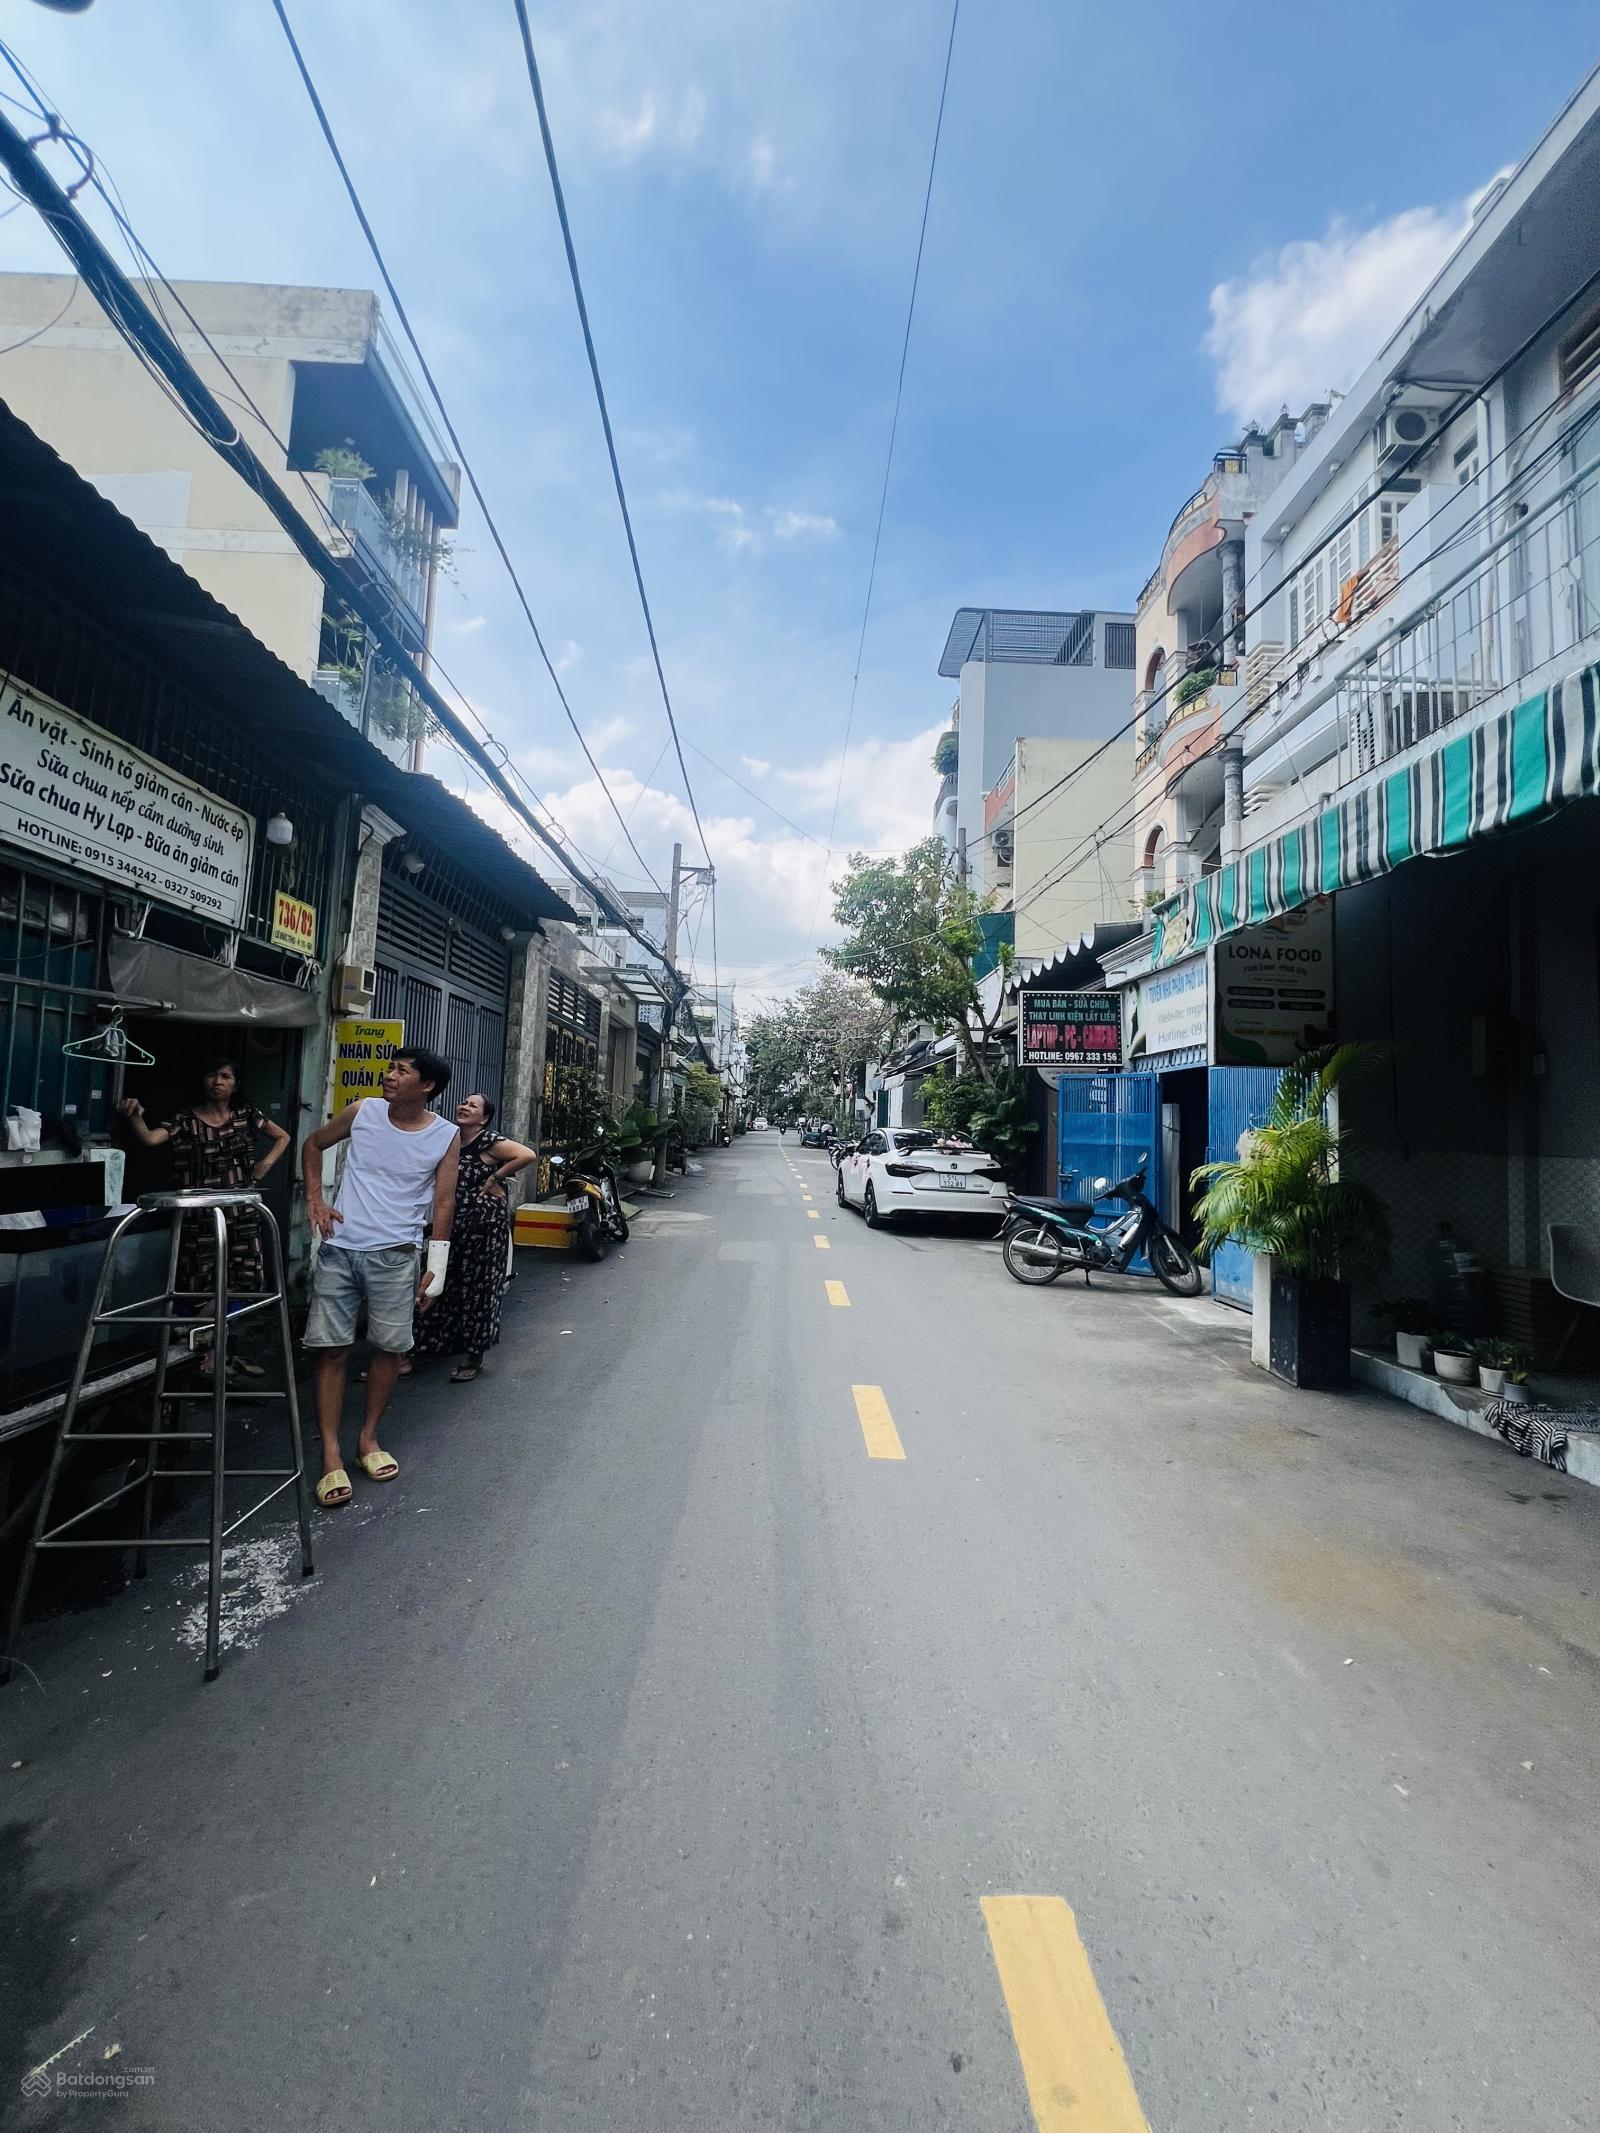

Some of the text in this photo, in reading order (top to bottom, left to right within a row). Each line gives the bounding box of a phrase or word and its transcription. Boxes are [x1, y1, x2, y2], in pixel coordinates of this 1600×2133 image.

[7, 694, 34, 728] Ăn
[39, 718, 68, 745] vặt
[79, 738, 114, 771] Sinh
[117, 760, 135, 779] tố
[134, 772, 168, 800] giảm
[171, 792, 193, 813] cân
[201, 805, 230, 833] Nước
[231, 822, 244, 842] ép
[37, 749, 224, 856] Sữa chua nếp cẩm dưỡng sinh
[0, 762, 35, 796] Sữa
[38, 784, 80, 816] chua
[83, 802, 106, 830] Hy
[107, 813, 134, 842] Lạp
[144, 831, 171, 857] Bữa
[172, 844, 189, 865] ăn
[189, 855, 219, 879] giảm
[220, 869, 239, 888] cân
[17, 817, 82, 854] HOTLINE:
[84, 846, 115, 867] 0915
[116, 859, 157, 884] 344242
[164, 879, 188, 896] 0327
[190, 889, 222, 910] 509292
[279, 899, 312, 936] 736/82
[1228, 945, 1322, 962] LONA FOOD
[1034, 999, 1050, 1008] MUA
[1052, 998, 1067, 1008] BÁN
[1028, 1011, 1047, 1021] THAY
[1049, 1011, 1066, 1021] LINH
[1067, 1010, 1083, 1022] KIỆN
[1085, 1010, 1098, 1021] LẤY
[355, 1025, 385, 1038] Trang
[1026, 1024, 1058, 1049] LAPTOP
[1064, 1024, 1077, 1049] PC
[1158, 1027, 1189, 1044] Hotline:
[339, 1041, 371, 1062] NHẬN
[1028, 1051, 1117, 1061] HOTLINE: 0967 333 156
[342, 1065, 373, 1088] QUẦN
